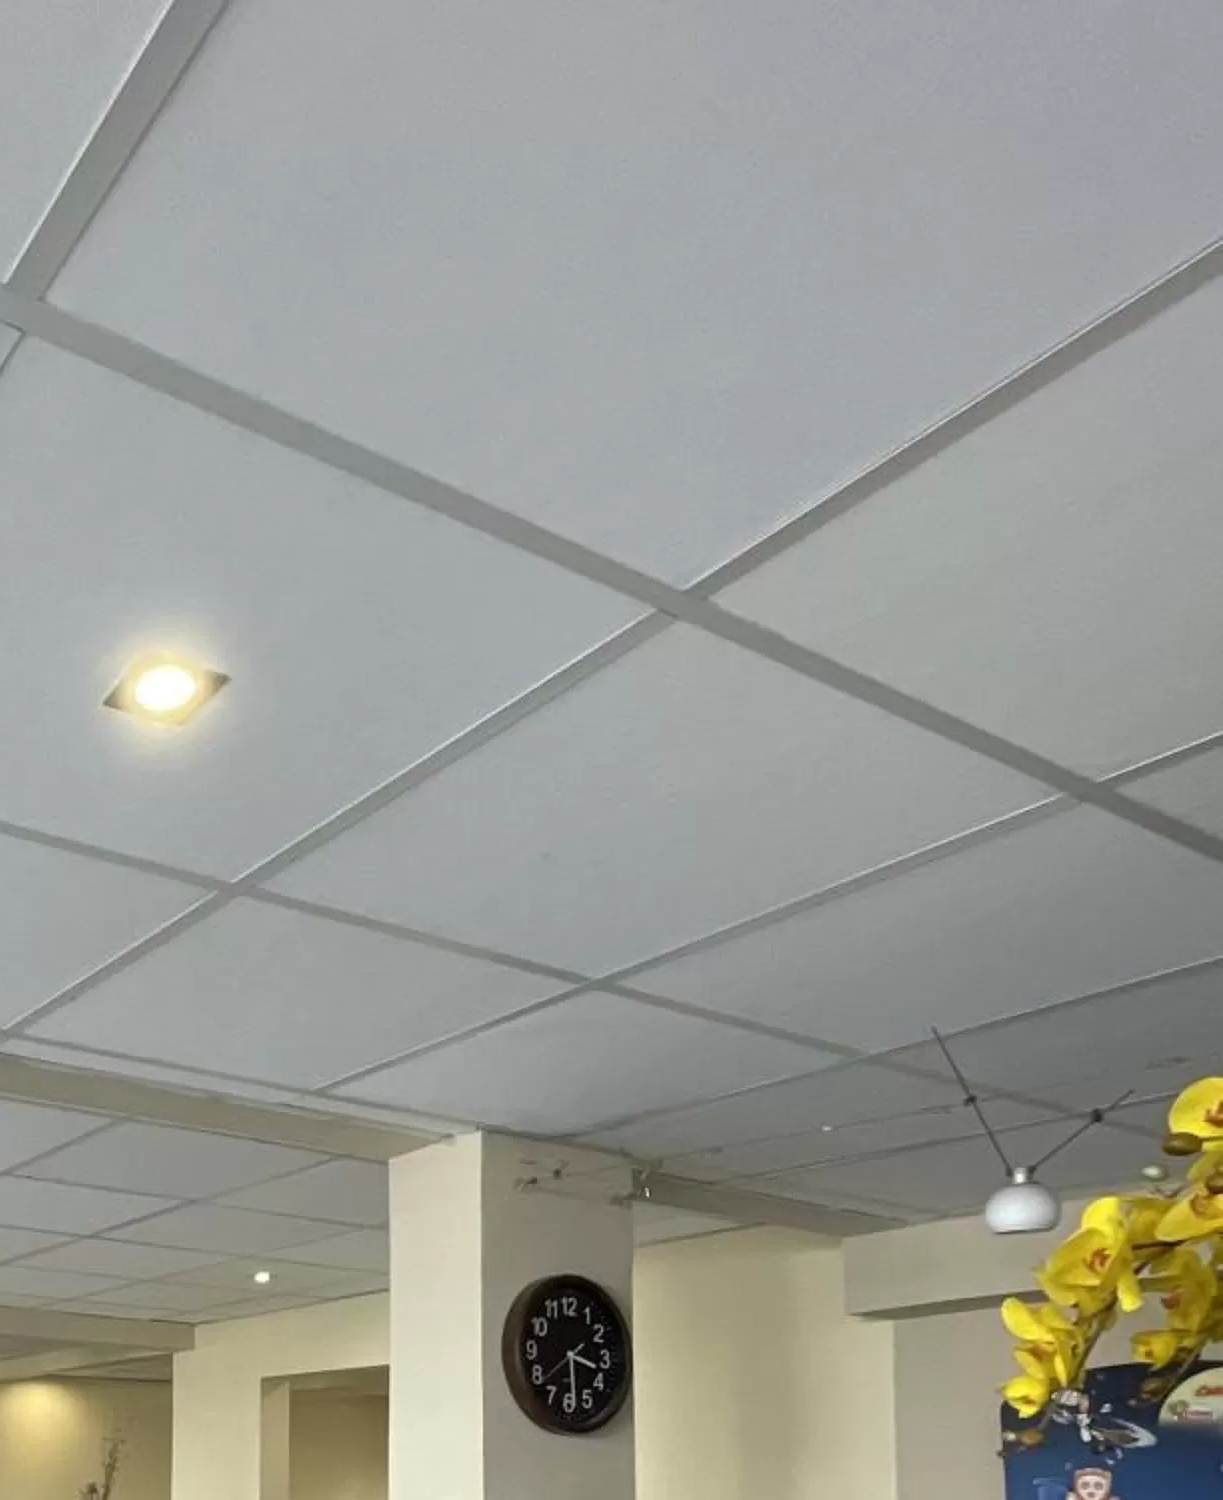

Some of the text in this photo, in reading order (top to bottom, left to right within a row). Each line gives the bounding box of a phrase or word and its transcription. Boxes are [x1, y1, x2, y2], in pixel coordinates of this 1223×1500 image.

[544, 1299, 559, 1319] 11
[562, 1297, 578, 1317] 12
[583, 1307, 592, 1325] 1
[531, 1317, 548, 1337] 10
[592, 1324, 605, 1343] 2
[526, 1340, 538, 1360] 9
[600, 1350, 611, 1369] 3
[532, 1365, 543, 1385] 8
[592, 1372, 604, 1391] 4
[546, 1386, 558, 1405] 7
[562, 1393, 576, 1413] 6
[582, 1389, 593, 1409] 5
